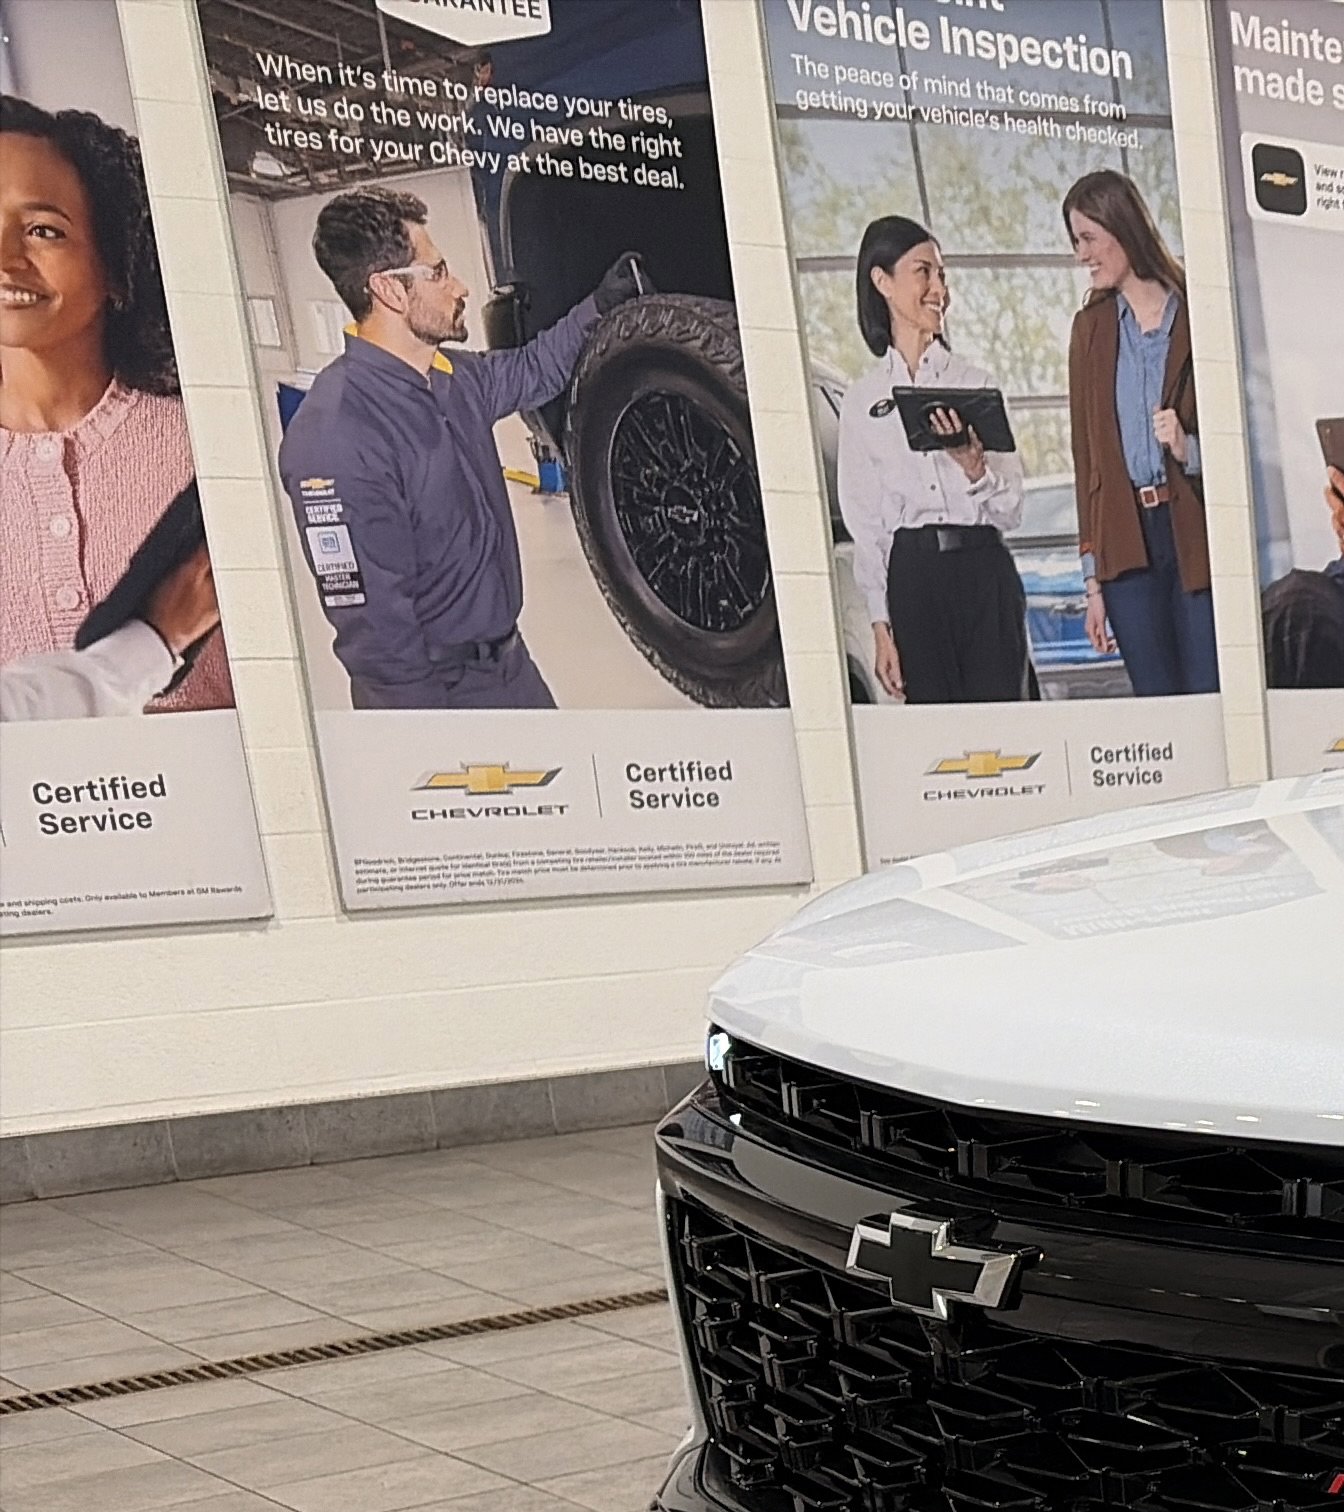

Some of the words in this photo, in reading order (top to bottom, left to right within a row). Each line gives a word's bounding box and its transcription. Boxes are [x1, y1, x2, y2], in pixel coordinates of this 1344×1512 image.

[787, 0, 930, 50] Vehicle
[940, 16, 1133, 80] Inspection
[256, 53, 333, 84] When
[338, 62, 377, 89] it's
[382, 70, 437, 96] time
[443, 78, 468, 101] to
[474, 84, 559, 111] replace
[563, 96, 612, 118] your
[618, 98, 673, 129] tires,
[791, 54, 829, 79] The
[835, 65, 894, 88] peace
[899, 71, 919, 91] of
[924, 75, 971, 98] mind
[976, 80, 1014, 104] that
[1019, 90, 1080, 113] comes
[1084, 94, 1127, 120] from
[1234, 64, 1325, 107] made
[256, 85, 291, 113] let
[297, 96, 327, 117] us
[333, 96, 364, 121] do
[370, 101, 411, 126] the
[416, 110, 482, 136] work.
[487, 114, 525, 140] We
[531, 118, 583, 147] have
[589, 126, 625, 151] the
[631, 131, 682, 159] right
[796, 89, 868, 119] getting
[873, 99, 916, 121] your
[920, 104, 1000, 131] vehicle's
[1004, 111, 1061, 139] health
[1065, 121, 1144, 150] checked.
[264, 122, 323, 150] tires
[328, 129, 364, 154] for
[370, 139, 423, 162] your
[429, 141, 500, 174] Chevy
[508, 153, 531, 174] at
[536, 152, 574, 178] the
[579, 156, 629, 184] best
[634, 163, 685, 190] deal.
[1314, 164, 1338, 178] View
[1316, 181, 1334, 193] and
[1316, 197, 1340, 211] right
[1090, 742, 1173, 764] Certified
[625, 760, 733, 783] Certified
[1093, 765, 1163, 787] Service
[32, 773, 167, 805] Certified
[629, 788, 720, 809] Service
[923, 784, 1047, 800] CHEVROLET
[38, 807, 153, 835] Service
[411, 804, 570, 820] CHEVROLET
